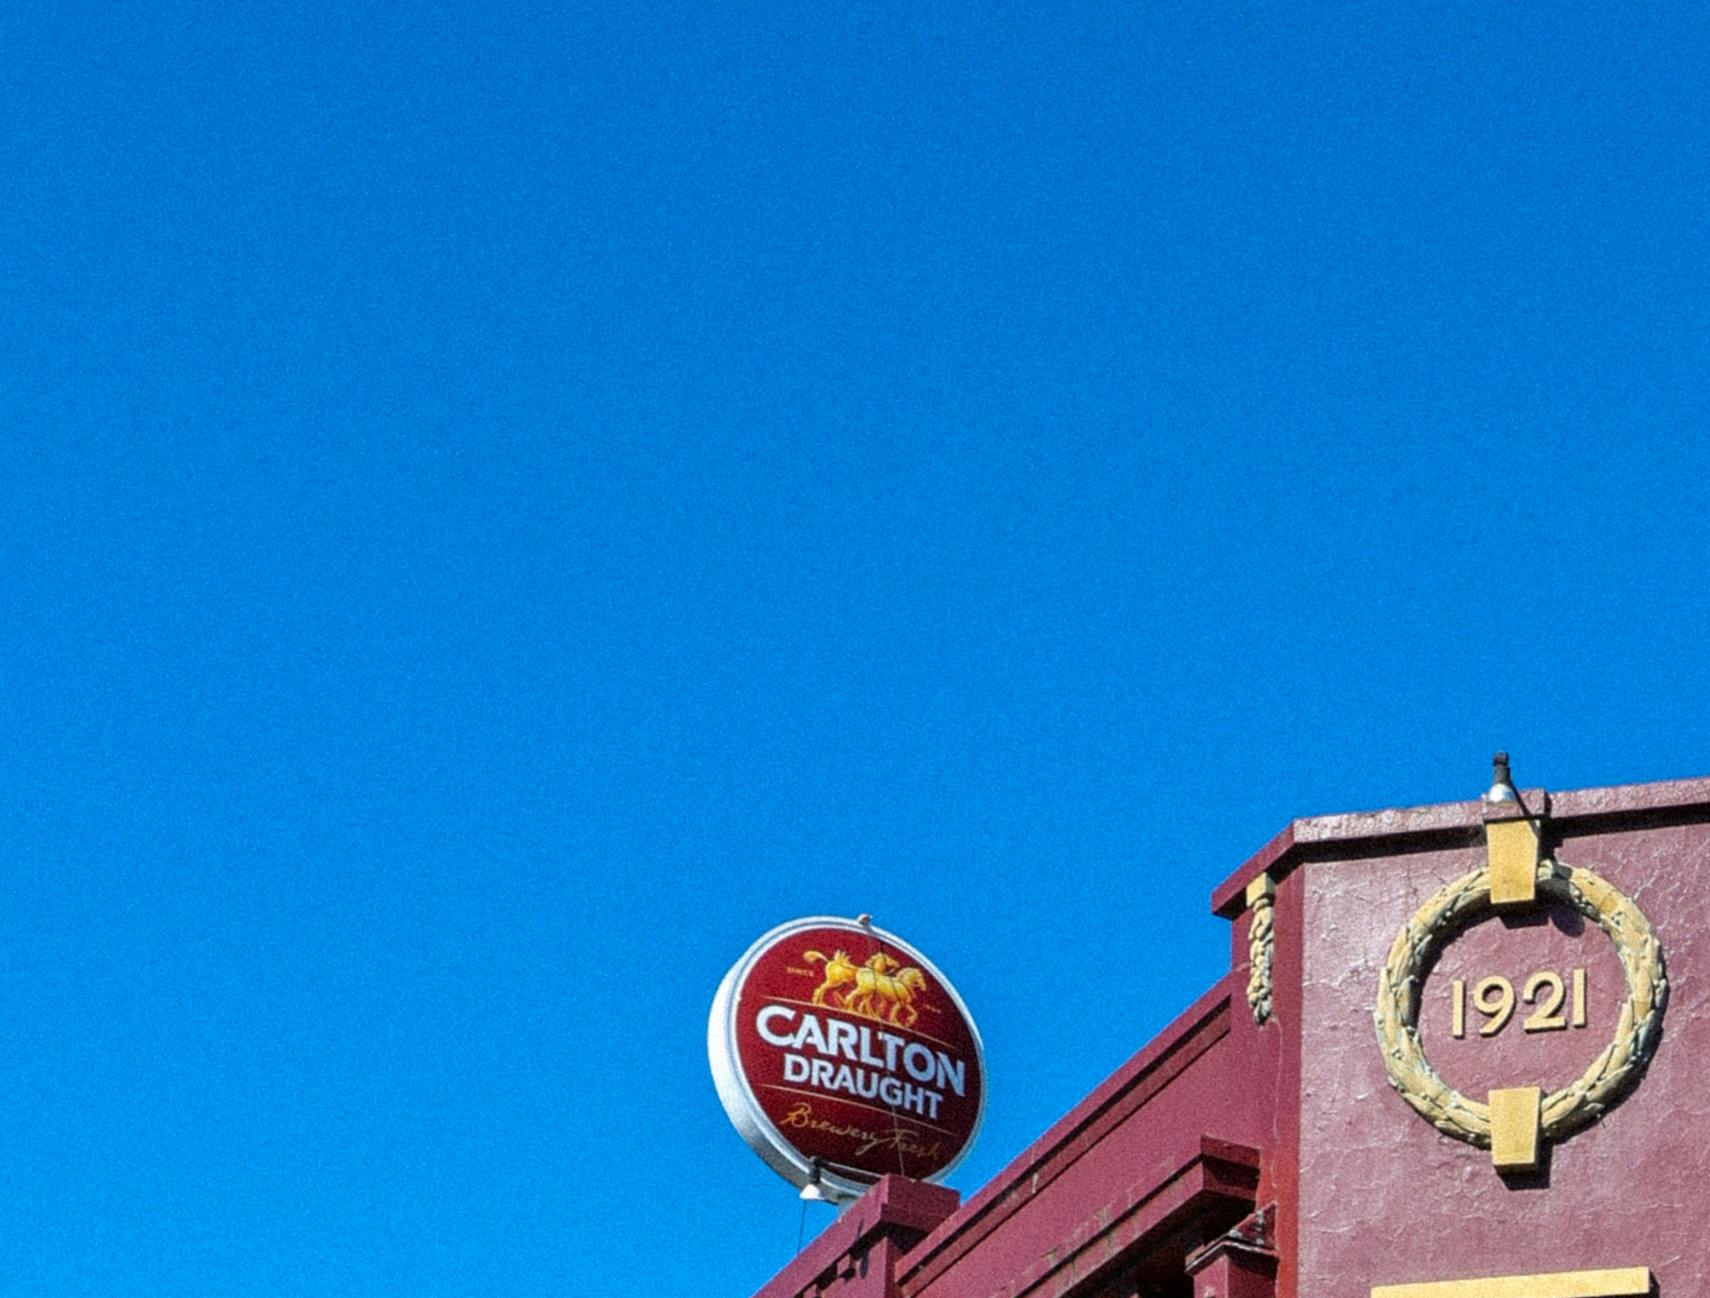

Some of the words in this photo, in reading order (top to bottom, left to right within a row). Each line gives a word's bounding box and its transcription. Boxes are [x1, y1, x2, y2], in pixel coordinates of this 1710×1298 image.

[1452, 967, 1587, 1038] 1921
[756, 1005, 965, 1096] CARLTON
[784, 1053, 943, 1119] DRAUGHT
[781, 1103, 878, 1156] Brewery
